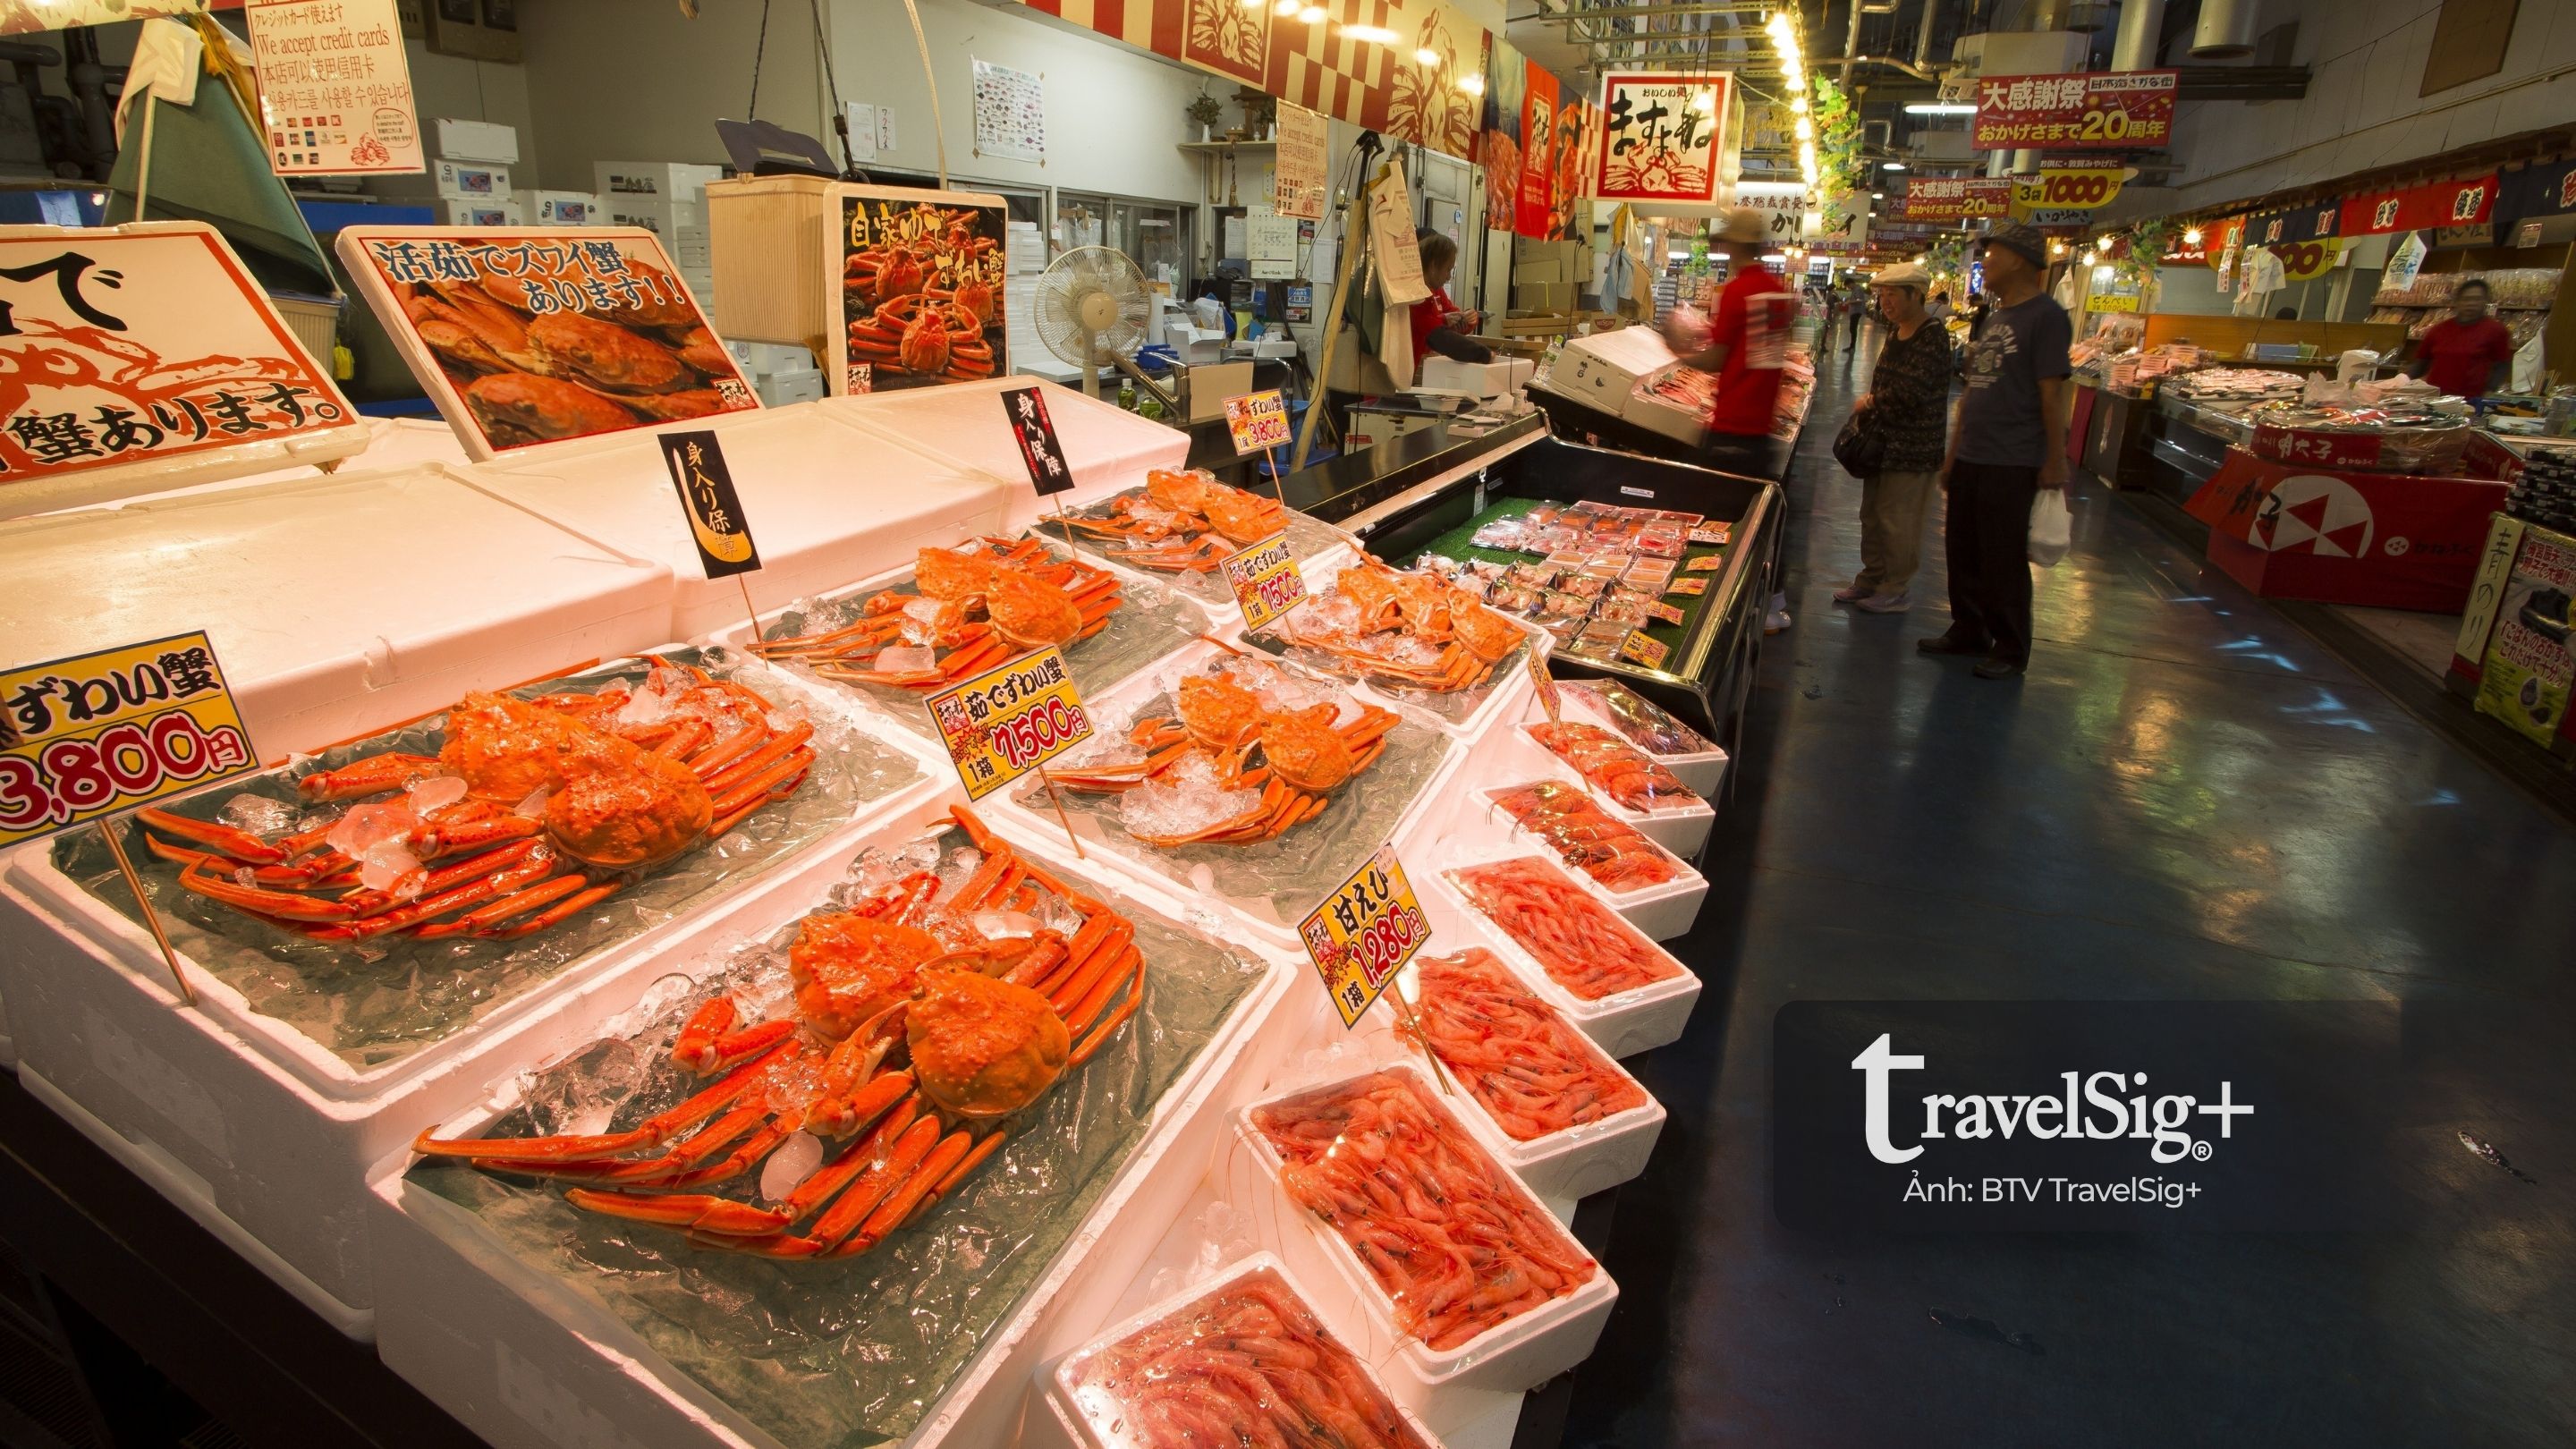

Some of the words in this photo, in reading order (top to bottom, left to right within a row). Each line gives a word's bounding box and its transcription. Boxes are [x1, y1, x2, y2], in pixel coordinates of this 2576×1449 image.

[255, 4, 343, 30] クレジットカード使えます
[257, 34, 276, 55] We
[281, 33, 318, 56] accept
[321, 27, 352, 51] credit
[358, 23, 390, 47] cards
[263, 54, 374, 85] 本店可以使用信用卡
[1981, 79, 2086, 112] 大感謝祭
[1978, 110, 2166, 141] おかげさまで20周年
[1907, 198, 2006, 216] おかげさまで20周年
[1910, 181, 1966, 199] 大感謝祭
[852, 201, 945, 250] 自家ゆで
[374, 240, 630, 283] 活茹でズワイ蟹
[521, 275, 685, 314] あります!!
[0, 383, 340, 471] 蟹あります。
[1017, 393, 1062, 477] 身入り保障
[686, 441, 739, 558] 身入り保障
[2467, 527, 2511, 650] 青のり
[7, 647, 221, 735] ずわい蟹
[964, 656, 1066, 723] 茹でずわい蟹
[991, 695, 1089, 769] 7,500円
[0, 710, 250, 830] 3,800円
[968, 757, 995, 783] 1箱
[1352, 900, 1425, 990] 1,280円
[1342, 980, 1365, 1014] 1箱
